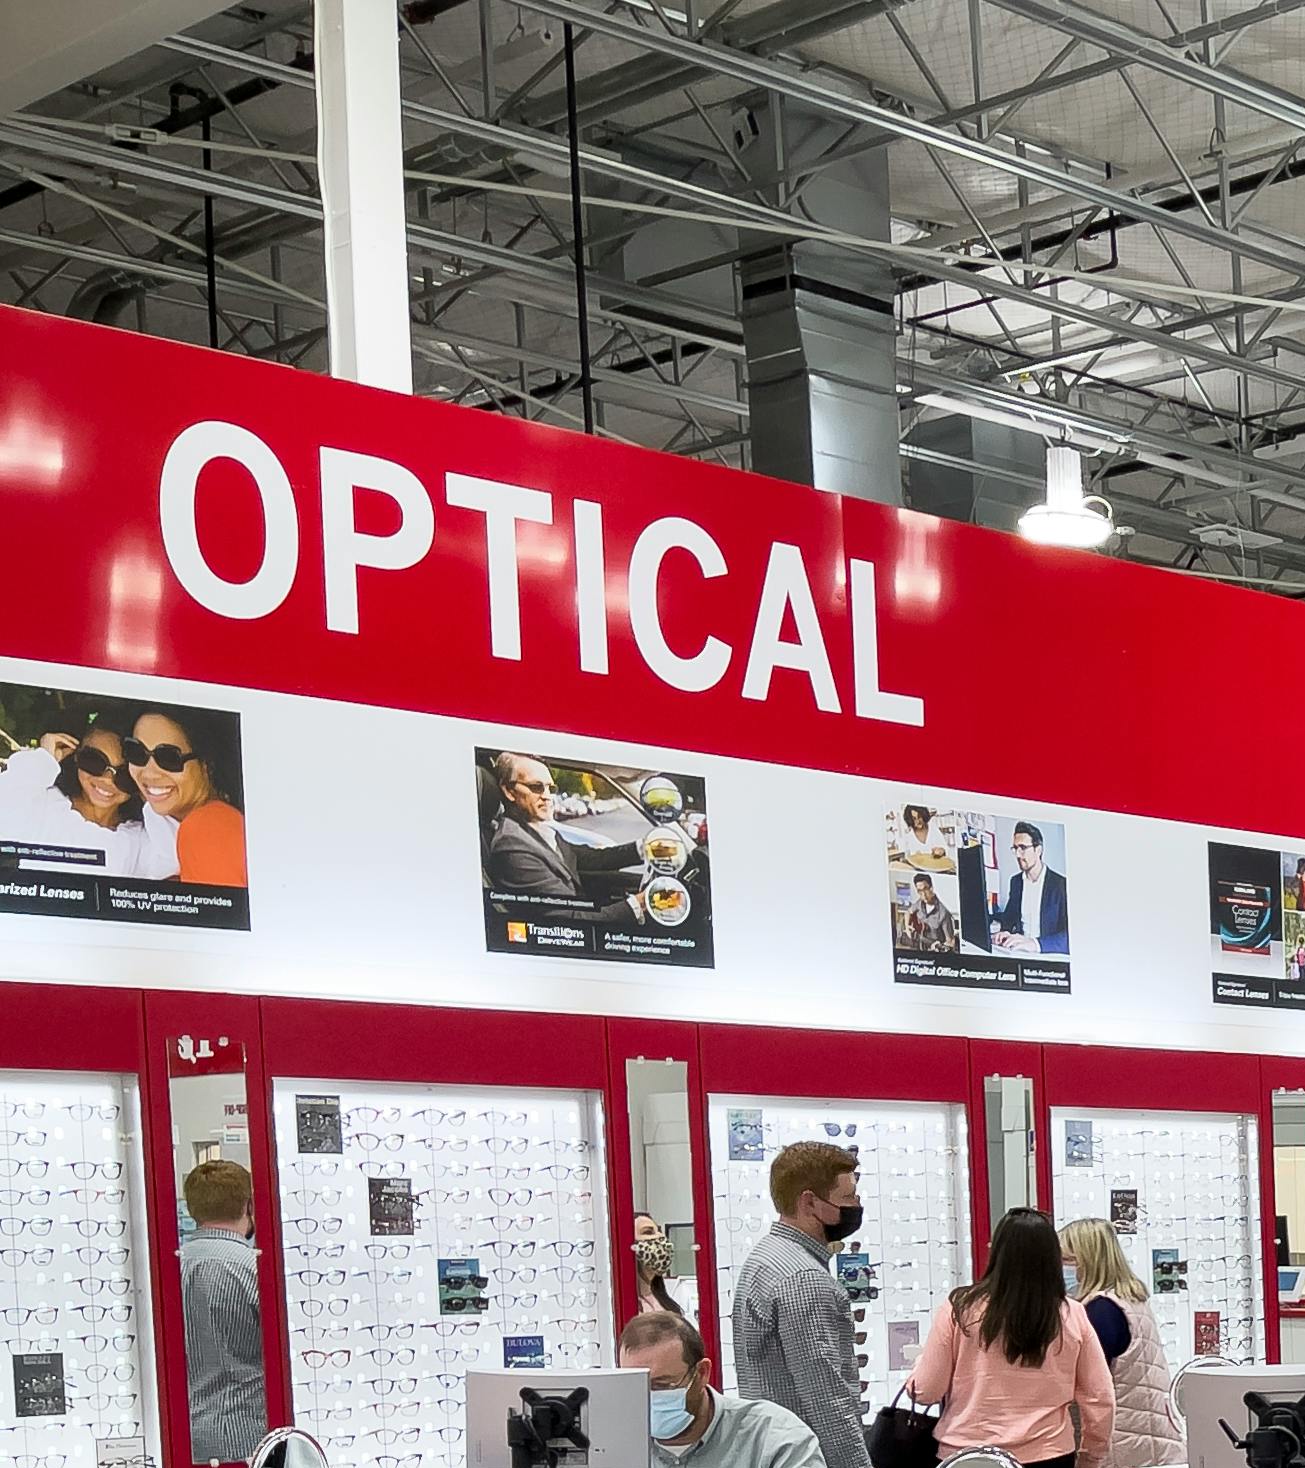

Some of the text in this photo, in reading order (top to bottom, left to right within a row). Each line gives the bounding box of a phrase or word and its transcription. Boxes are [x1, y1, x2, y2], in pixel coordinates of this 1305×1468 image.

[159, 420, 924, 727] OPTICAL
[40, 885, 85, 900] Lenses
[109, 887, 233, 907] Reduces glare and provides
[111, 899, 199, 914] 100% UV protection
[527, 923, 585, 939] Transitions
[604, 932, 611, 940] A
[897, 964, 910, 975] HD
[910, 965, 936, 977] Digital
[936, 966, 959, 978] Office
[960, 969, 997, 981] Computer
[1217, 987, 1244, 998] Contact
[1245, 989, 1269, 999] Lenses
